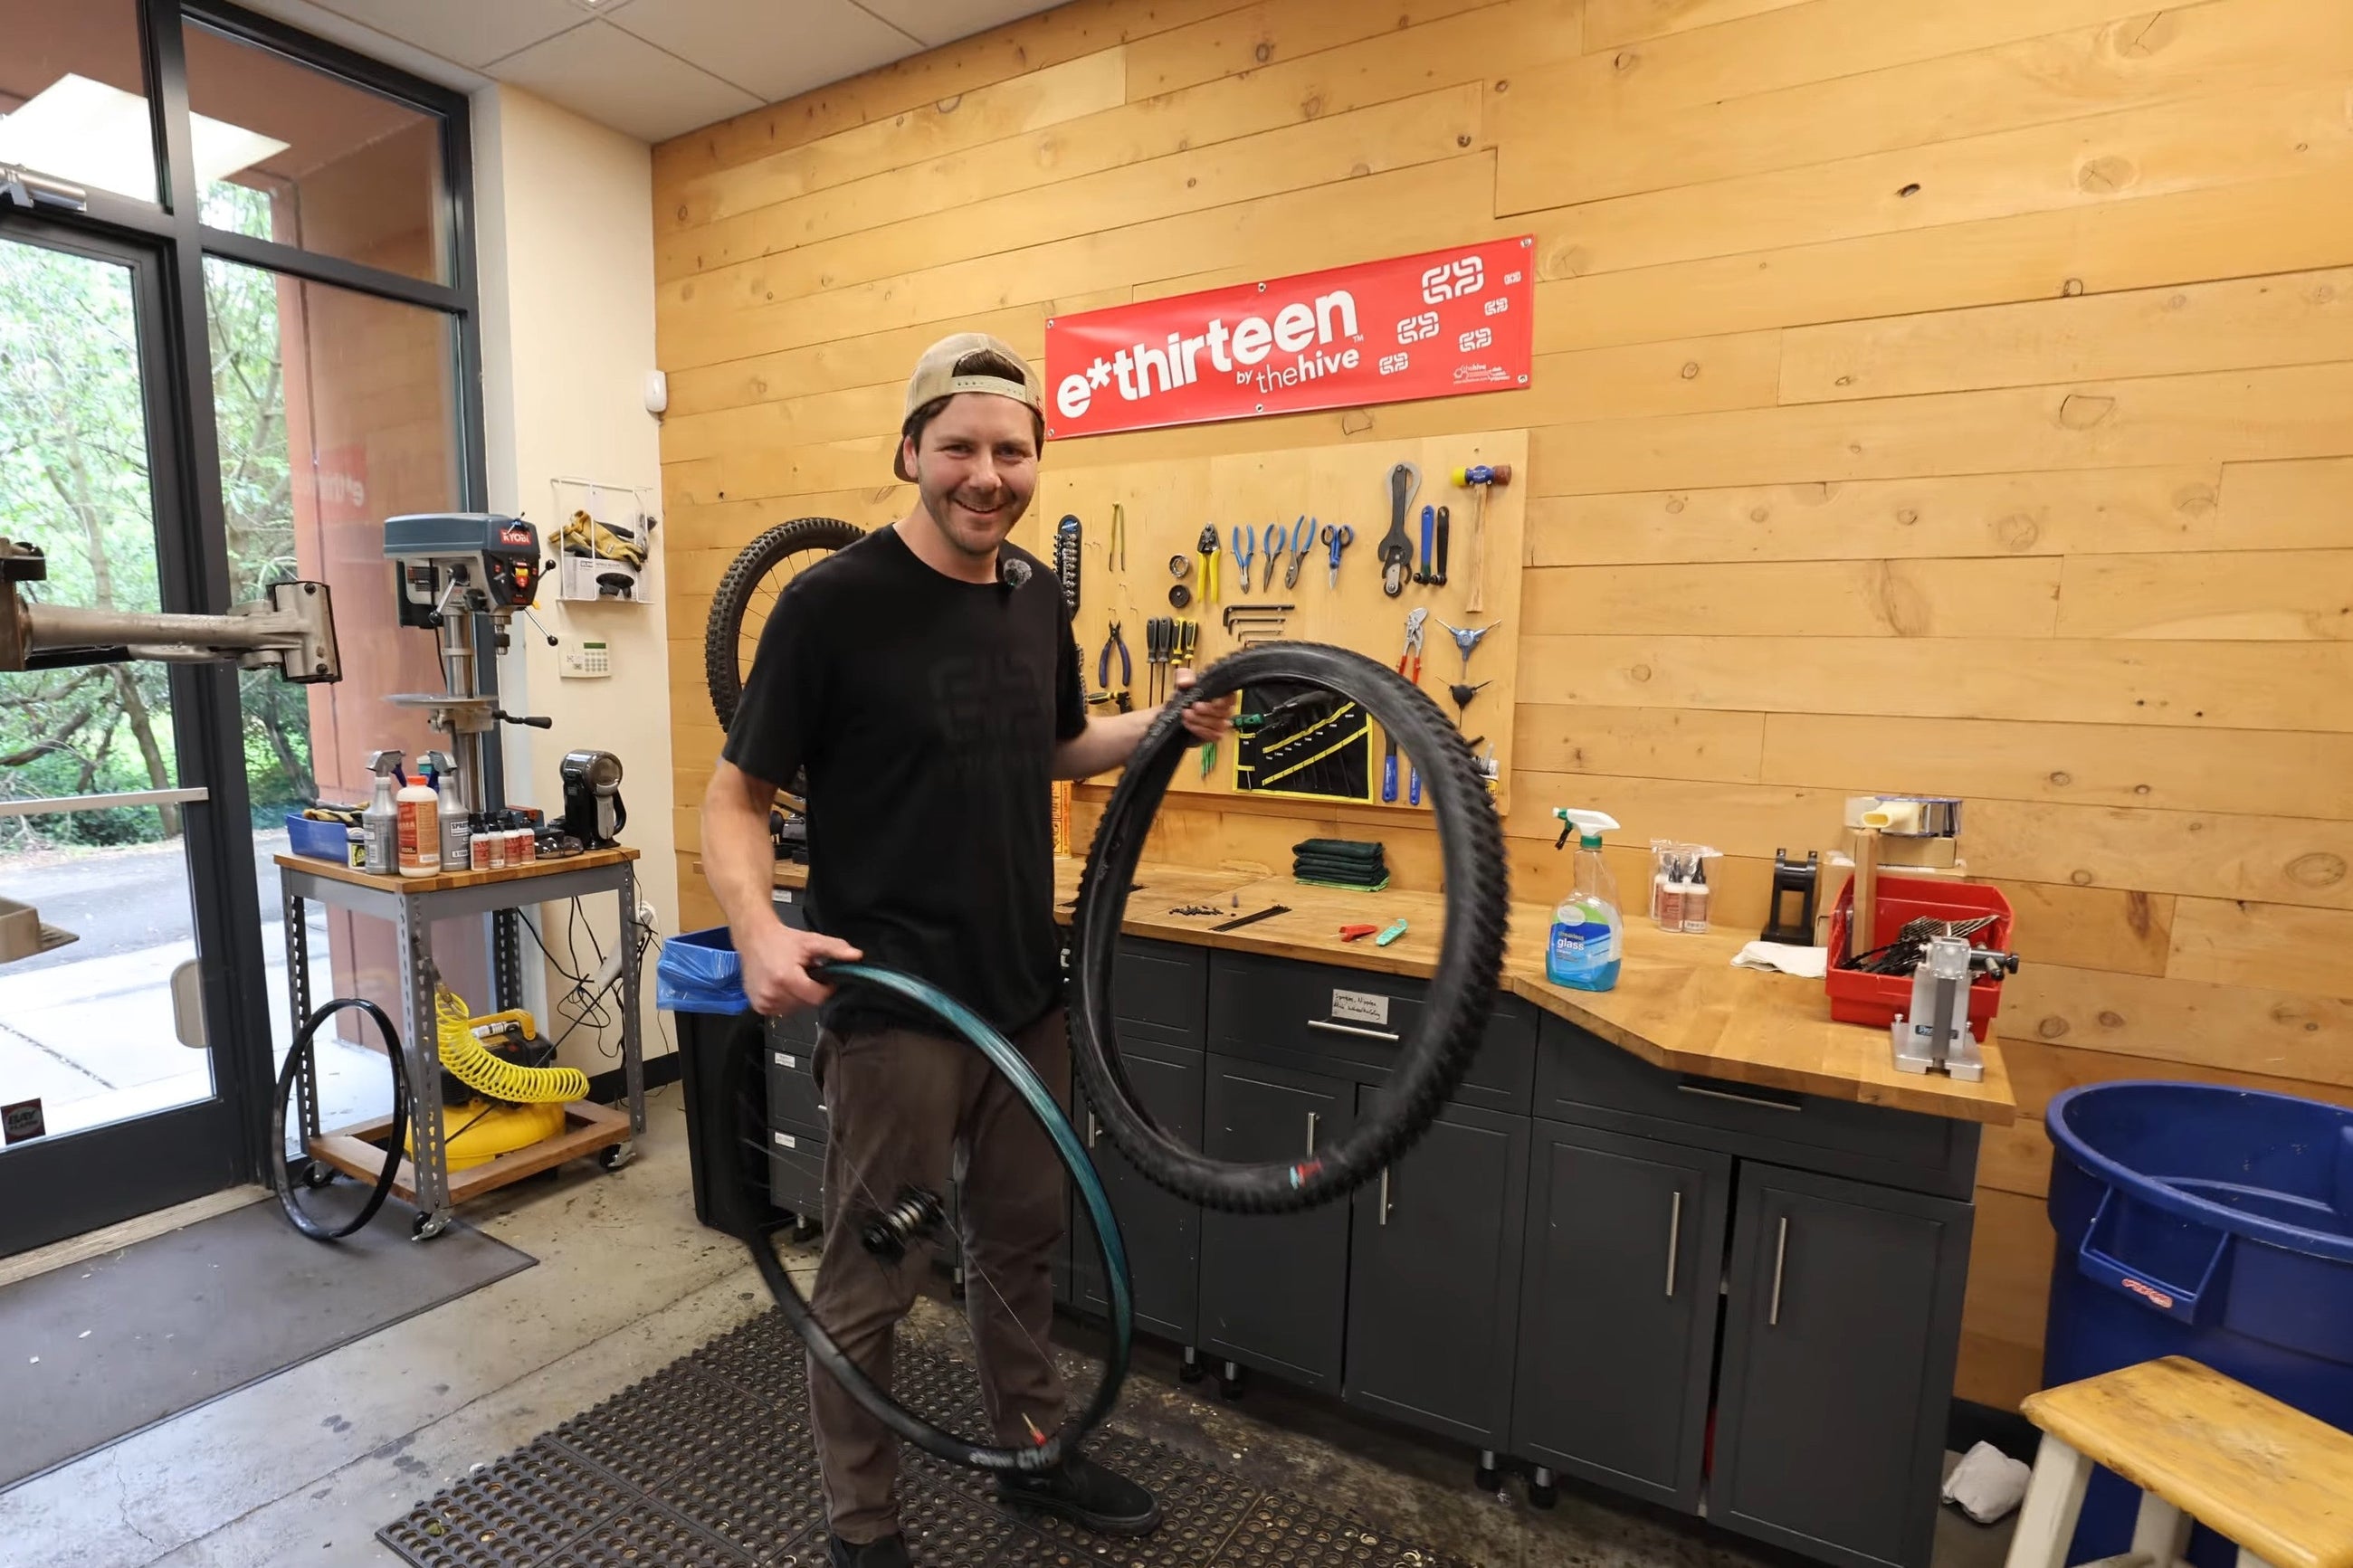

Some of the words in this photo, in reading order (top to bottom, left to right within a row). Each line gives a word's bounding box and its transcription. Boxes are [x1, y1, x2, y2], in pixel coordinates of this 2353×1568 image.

[1236, 369, 1253, 385] by
[1256, 348, 1359, 394] thehive
[502, 531, 530, 543] RYOBI
[1557, 937, 1585, 951] glass
